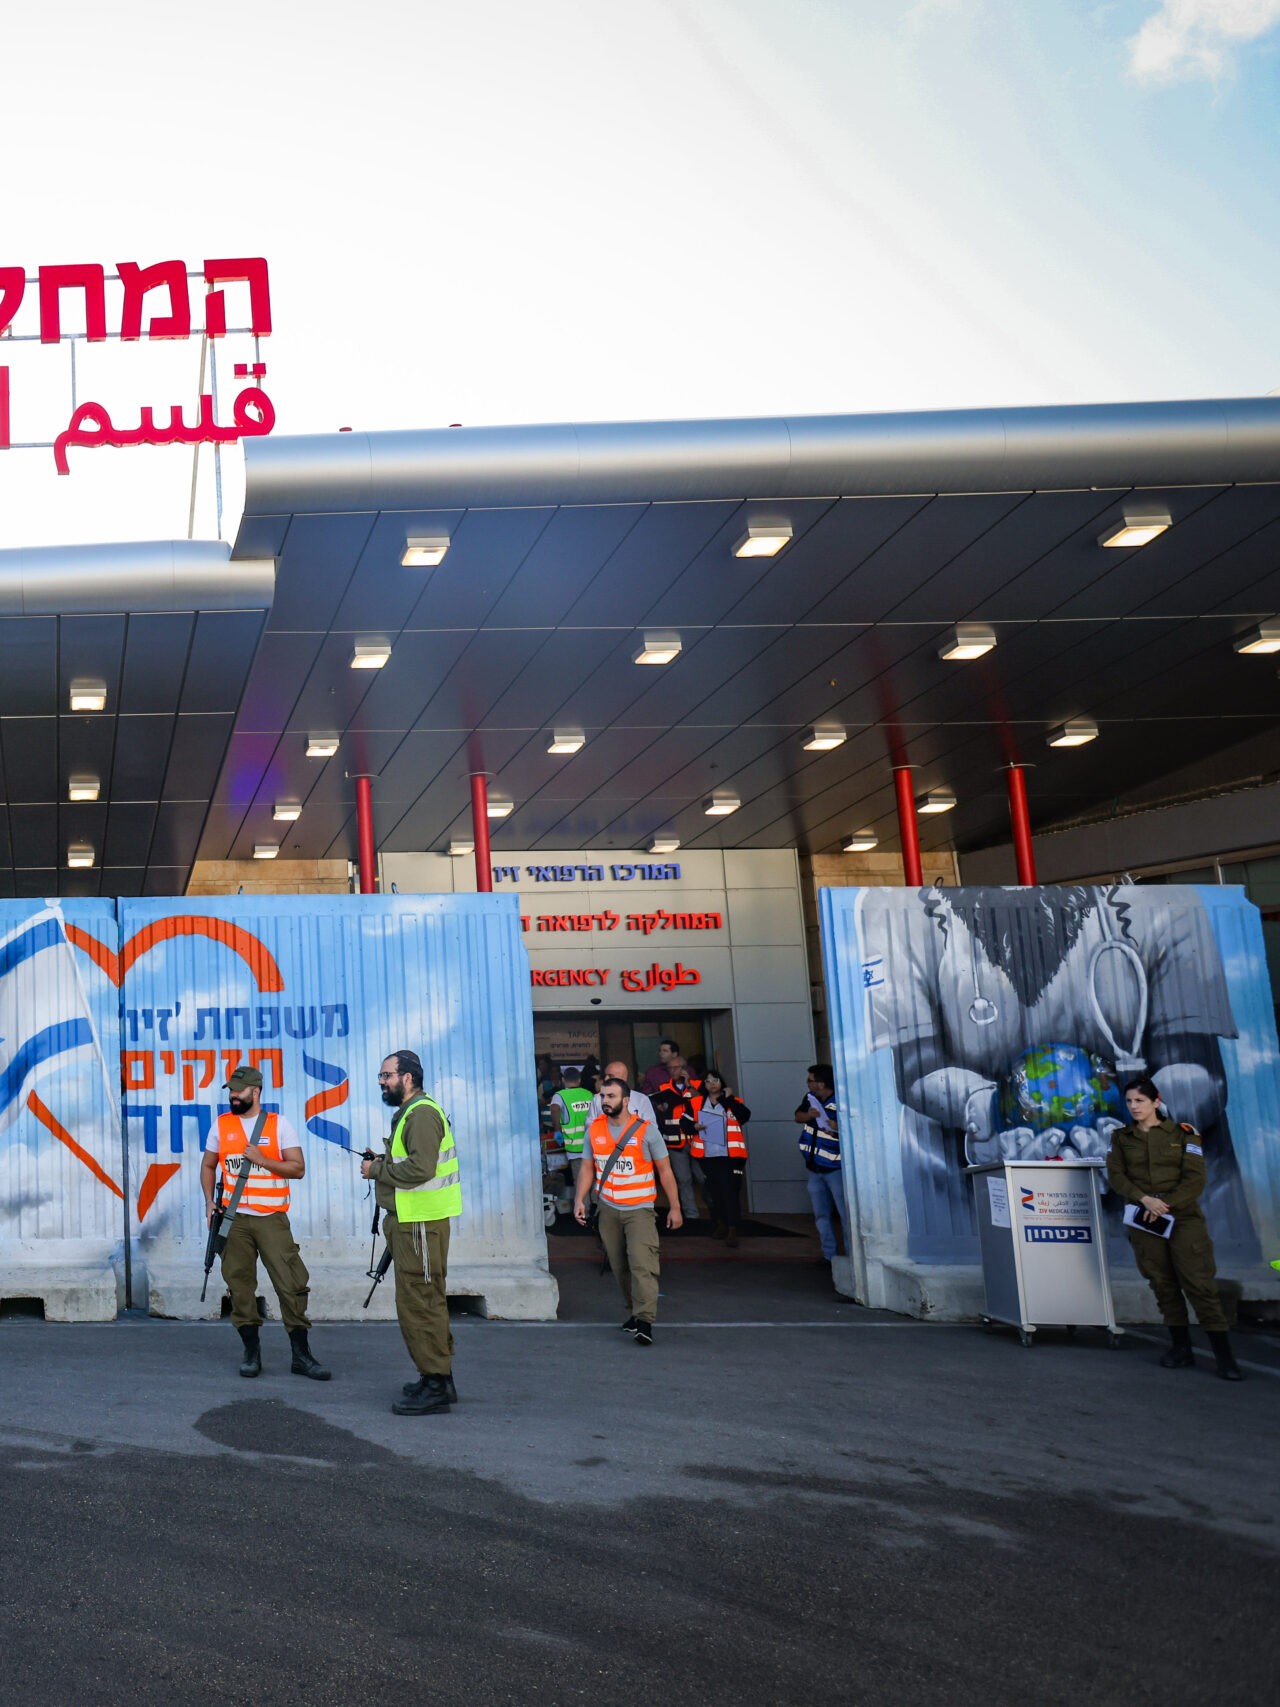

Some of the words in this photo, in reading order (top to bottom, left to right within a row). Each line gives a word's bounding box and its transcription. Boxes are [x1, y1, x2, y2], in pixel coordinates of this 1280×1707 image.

[54, 363, 276, 475] قسم
[493, 866, 520, 882] זיו
[526, 864, 604, 882] הרפואי
[611, 863, 681, 881] המרכז
[537, 910, 620, 932] לרפואה
[627, 909, 722, 935] המחלקה
[531, 969, 610, 987] RGENCY
[621, 963, 701, 992] طوارئ
[193, 1004, 349, 1041] משפחת
[1027, 1228, 1090, 1242] ביטחון
